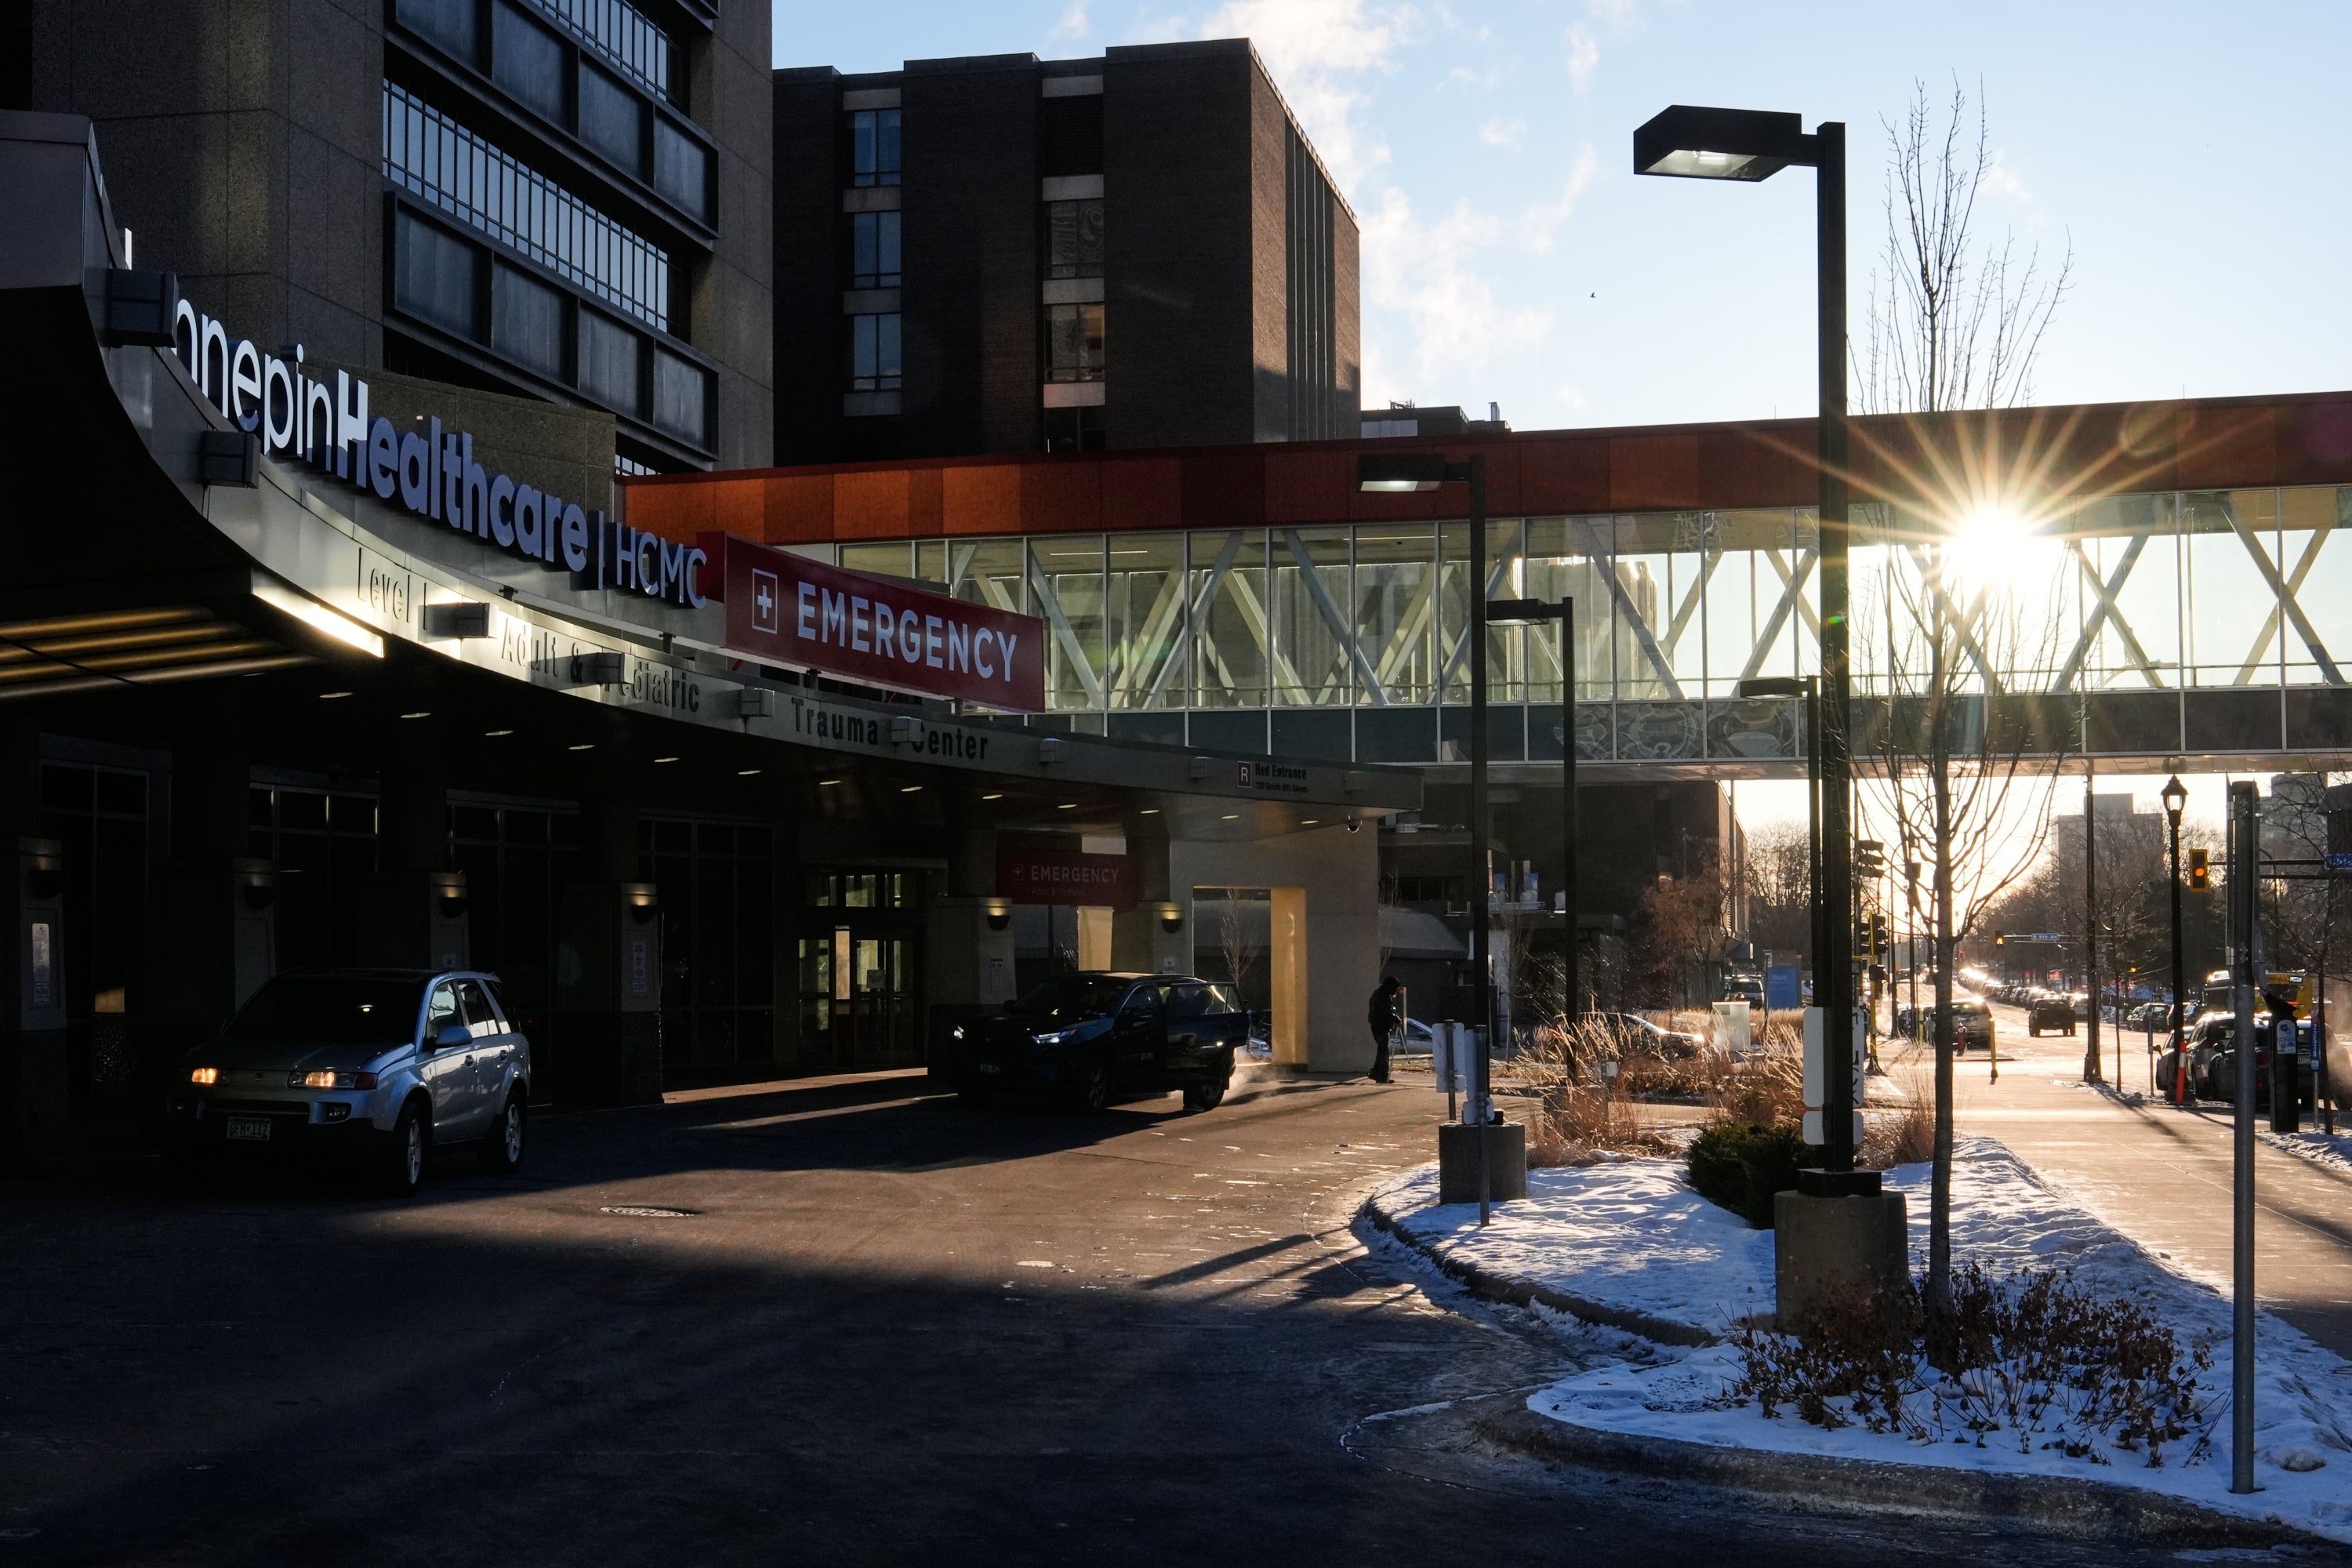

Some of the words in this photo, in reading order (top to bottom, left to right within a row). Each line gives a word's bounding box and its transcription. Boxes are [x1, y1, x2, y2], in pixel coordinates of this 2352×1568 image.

[616, 526, 707, 608] HCMC
[358, 547, 412, 623] Level
[501, 617, 559, 678] Adult
[571, 641, 583, 684] &
[604, 661, 699, 713] diatric
[791, 696, 878, 745] Trauma
[797, 580, 1018, 682] EMERGENCY
[1240, 767, 1249, 782] R
[1255, 763, 1269, 776] Red
[1272, 764, 1307, 779] Entrance
[1030, 865, 1120, 884] EMERGENCY
